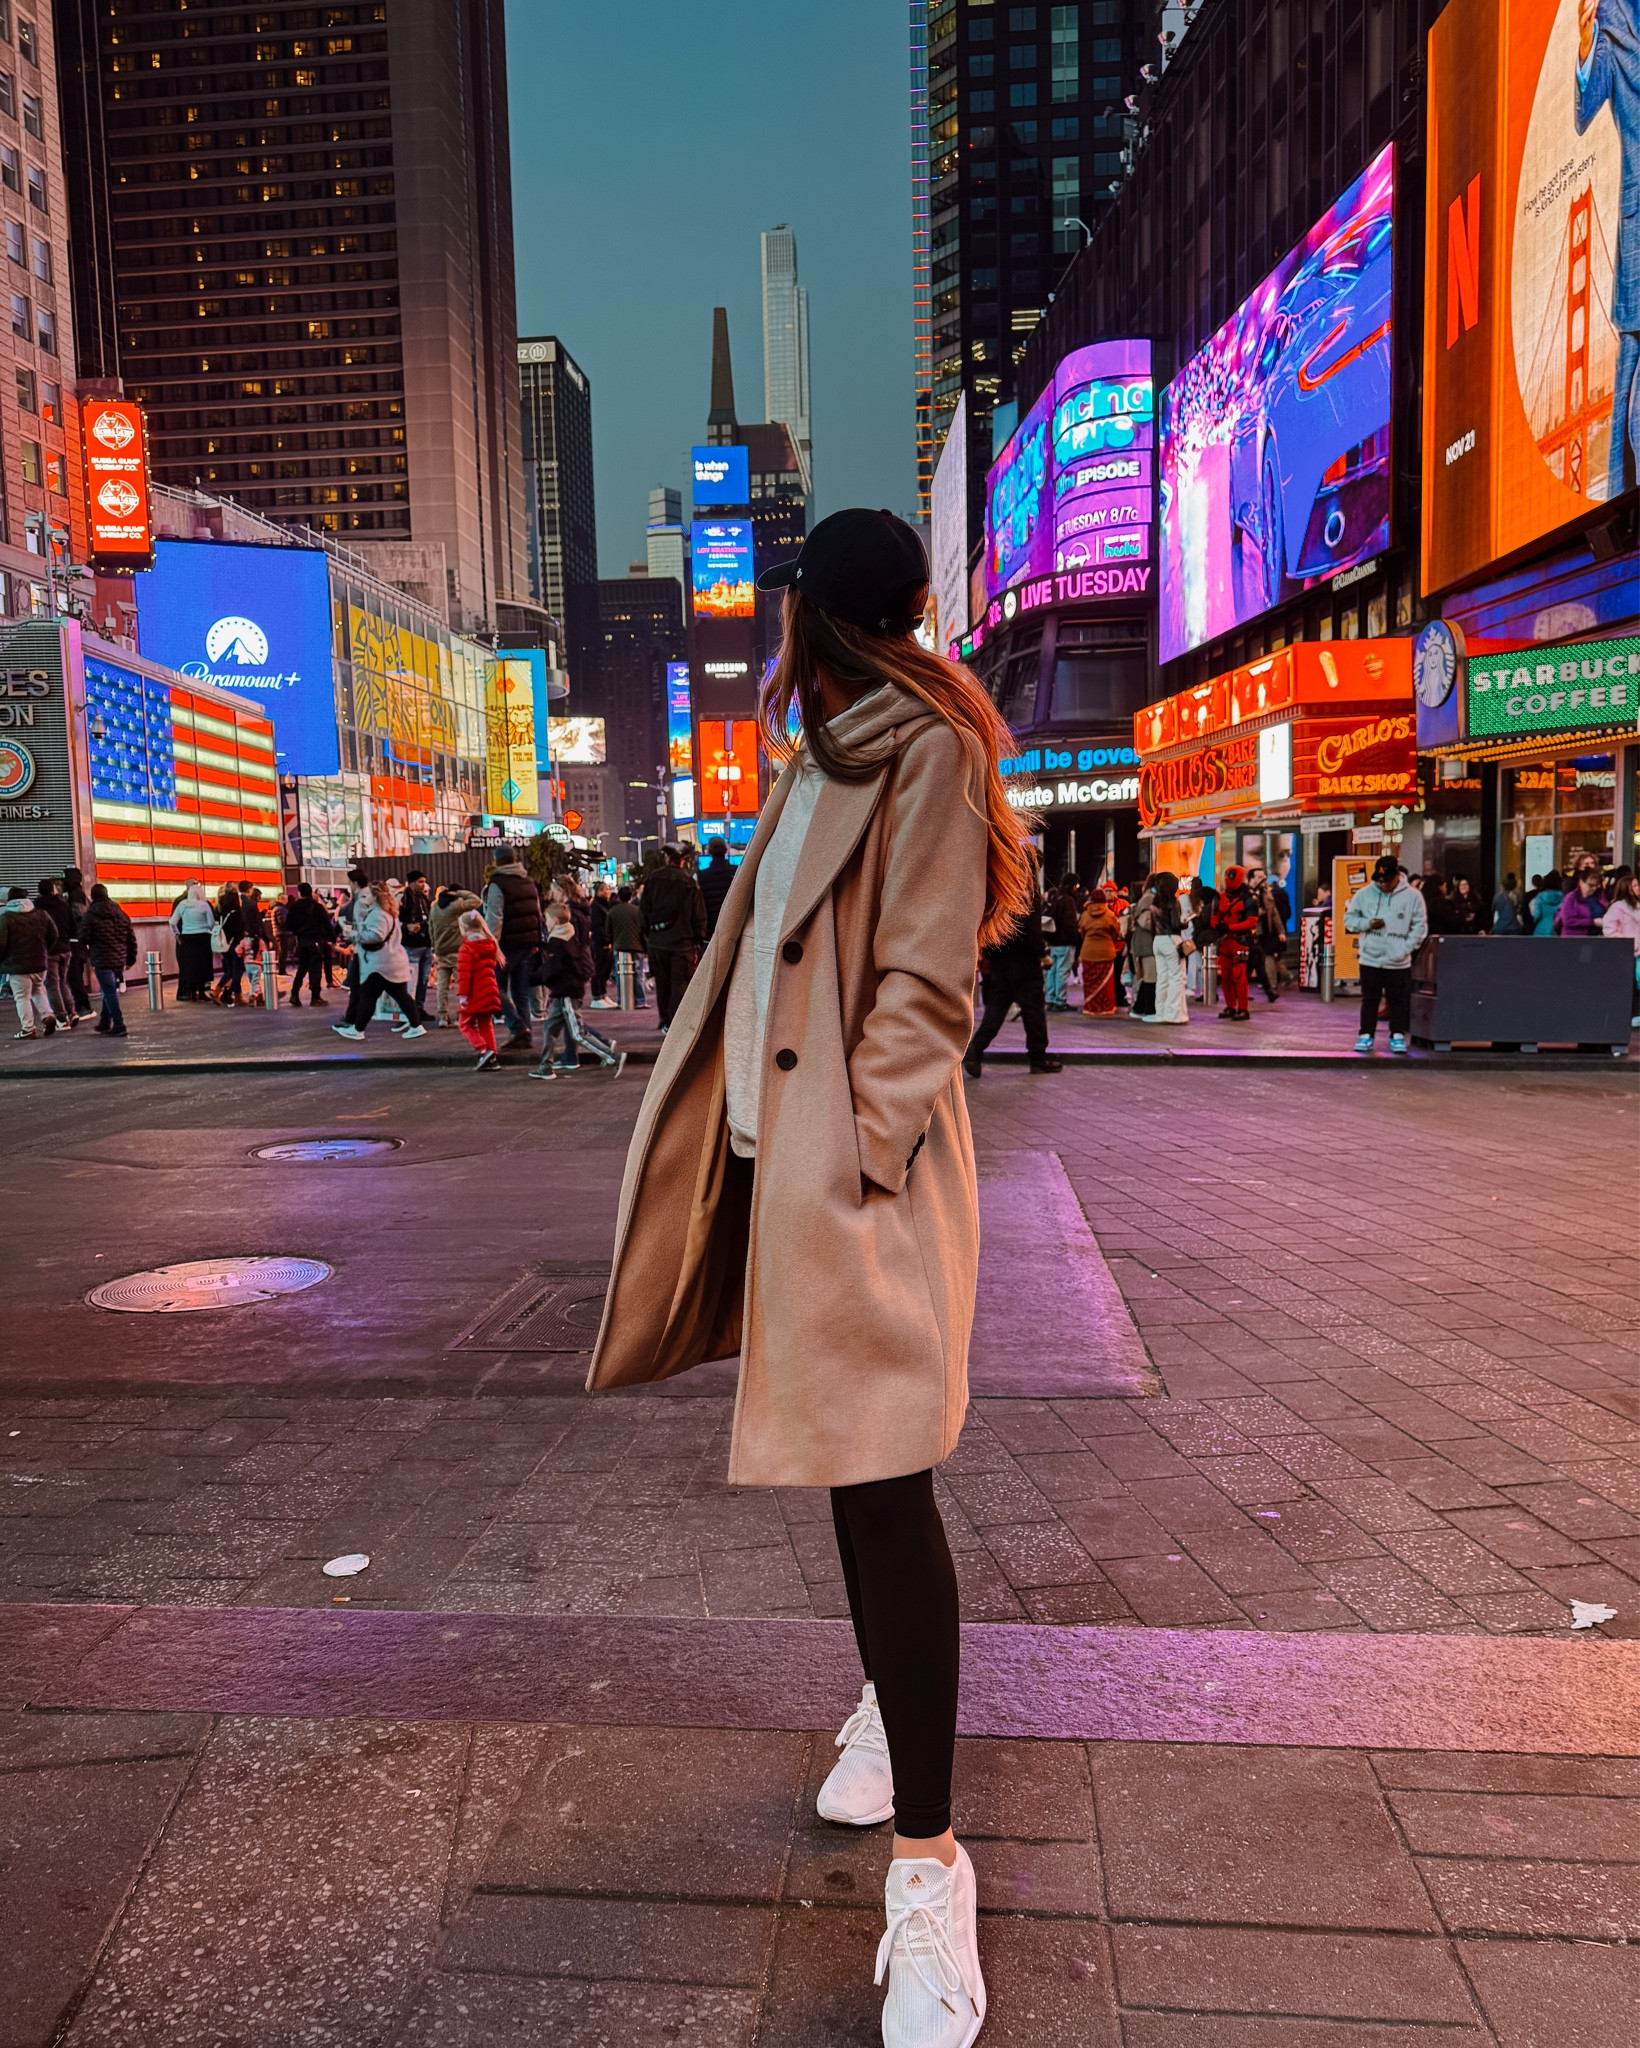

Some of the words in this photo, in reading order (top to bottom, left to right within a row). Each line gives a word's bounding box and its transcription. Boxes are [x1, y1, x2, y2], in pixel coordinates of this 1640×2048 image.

[1524, 194, 1538, 216] How
[1539, 186, 1546, 200] he
[1548, 171, 1558, 195] got
[1559, 158, 1574, 180] here
[1541, 189, 1554, 212] kind
[1555, 181, 1562, 198] of
[1446, 172, 1481, 350] N
[1446, 436, 1464, 465] NOV
[1464, 429, 1475, 452] 21
[1077, 461, 1140, 487] EPISODE
[1064, 509, 1107, 535] TUESDAY
[1110, 506, 1139, 523] 8/7c
[1104, 541, 1140, 558] hulu
[1021, 580, 1052, 611] LIVE
[1055, 567, 1151, 600] TUESDAY
[705, 662, 747, 673] SAMSUNG
[1506, 684, 1627, 716] COFFEE
[1227, 738, 1256, 765] BAKE
[1318, 717, 1410, 774] CARLO'S
[1014, 749, 1040, 773] will
[1044, 748, 1072, 770] be
[1227, 763, 1257, 790] SHOP
[1319, 774, 1363, 795] BAKE
[1364, 772, 1411, 792] SHOP
